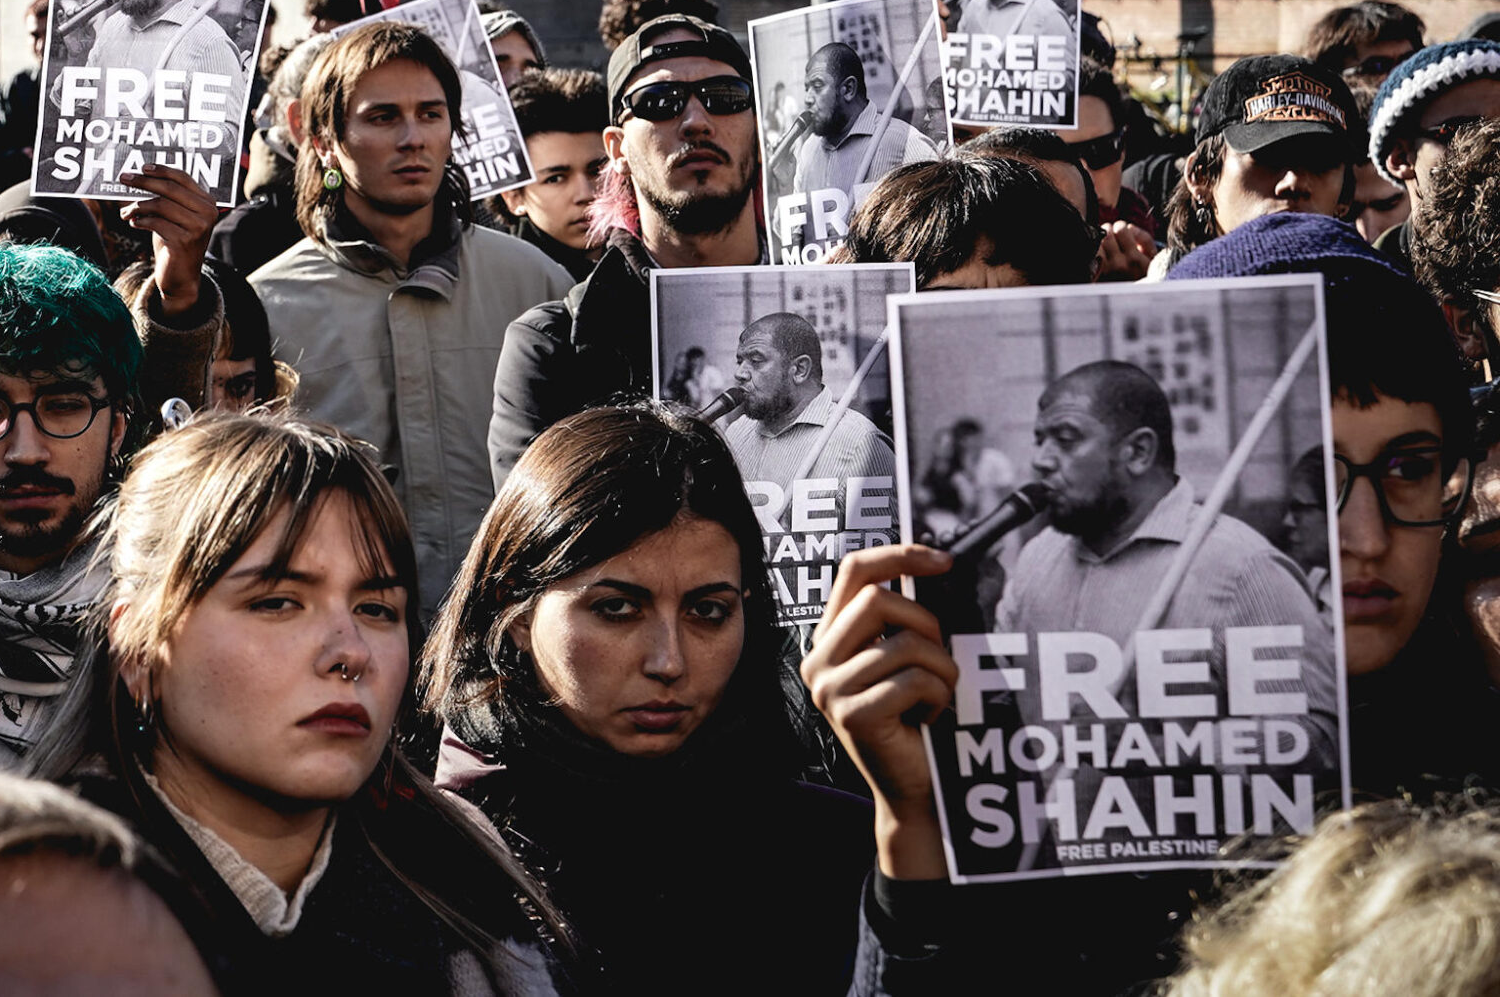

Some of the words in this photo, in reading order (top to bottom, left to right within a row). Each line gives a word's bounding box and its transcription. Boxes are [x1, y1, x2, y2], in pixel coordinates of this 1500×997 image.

[945, 33, 1066, 71] FREE
[60, 66, 232, 122] FREE
[1249, 92, 1343, 122] HARLEY-DAVIDSON
[56, 119, 223, 149] MOHAMED
[100, 184, 127, 193] FREE
[743, 476, 893, 533] REE
[951, 625, 1308, 726] FREE
[955, 721, 1310, 777] MOHAMED
[965, 774, 1314, 849] SHAHIN
[1057, 843, 1106, 861] FREE
[1111, 839, 1219, 857] PALESTINE
